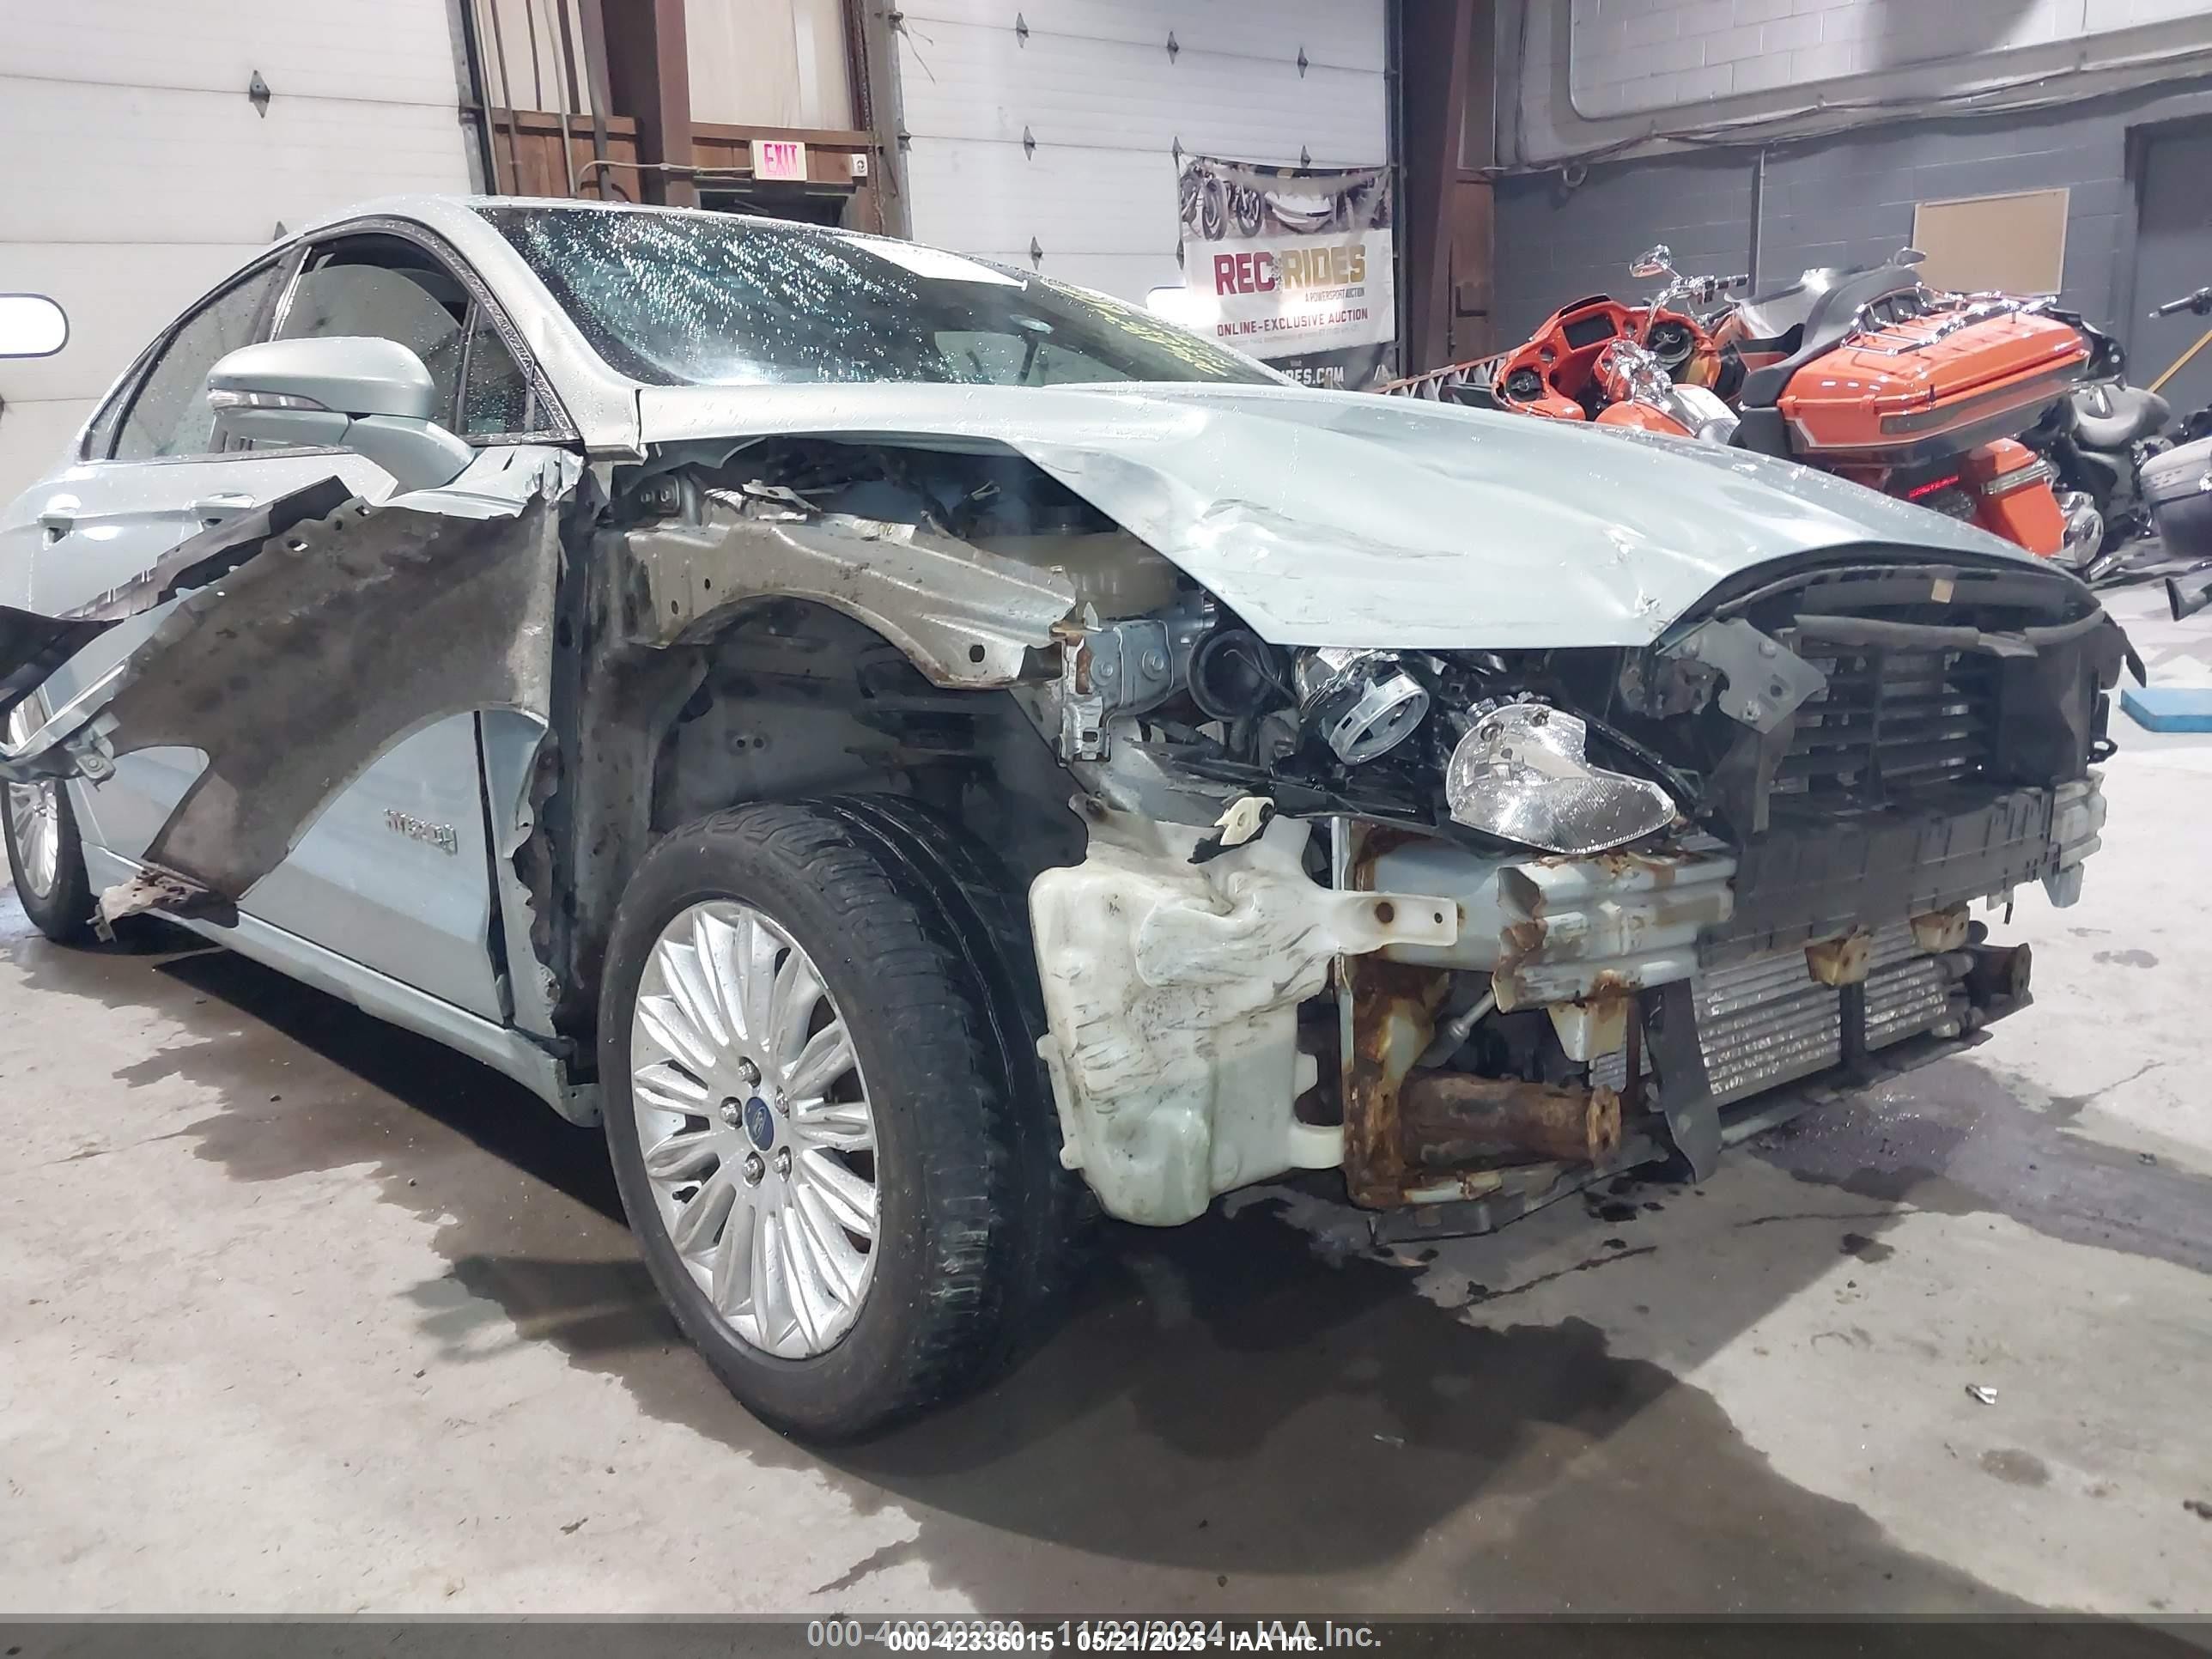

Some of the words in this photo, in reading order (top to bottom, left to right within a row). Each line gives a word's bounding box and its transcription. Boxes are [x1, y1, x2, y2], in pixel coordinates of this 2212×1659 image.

[763, 143, 797, 176] EXIT
[1213, 252, 1275, 295] REC
[1280, 244, 1366, 289] RIDES
[1217, 313, 1324, 337] ONLINE-EXCLUSIVE
[1328, 307, 1368, 324] AUCTION
